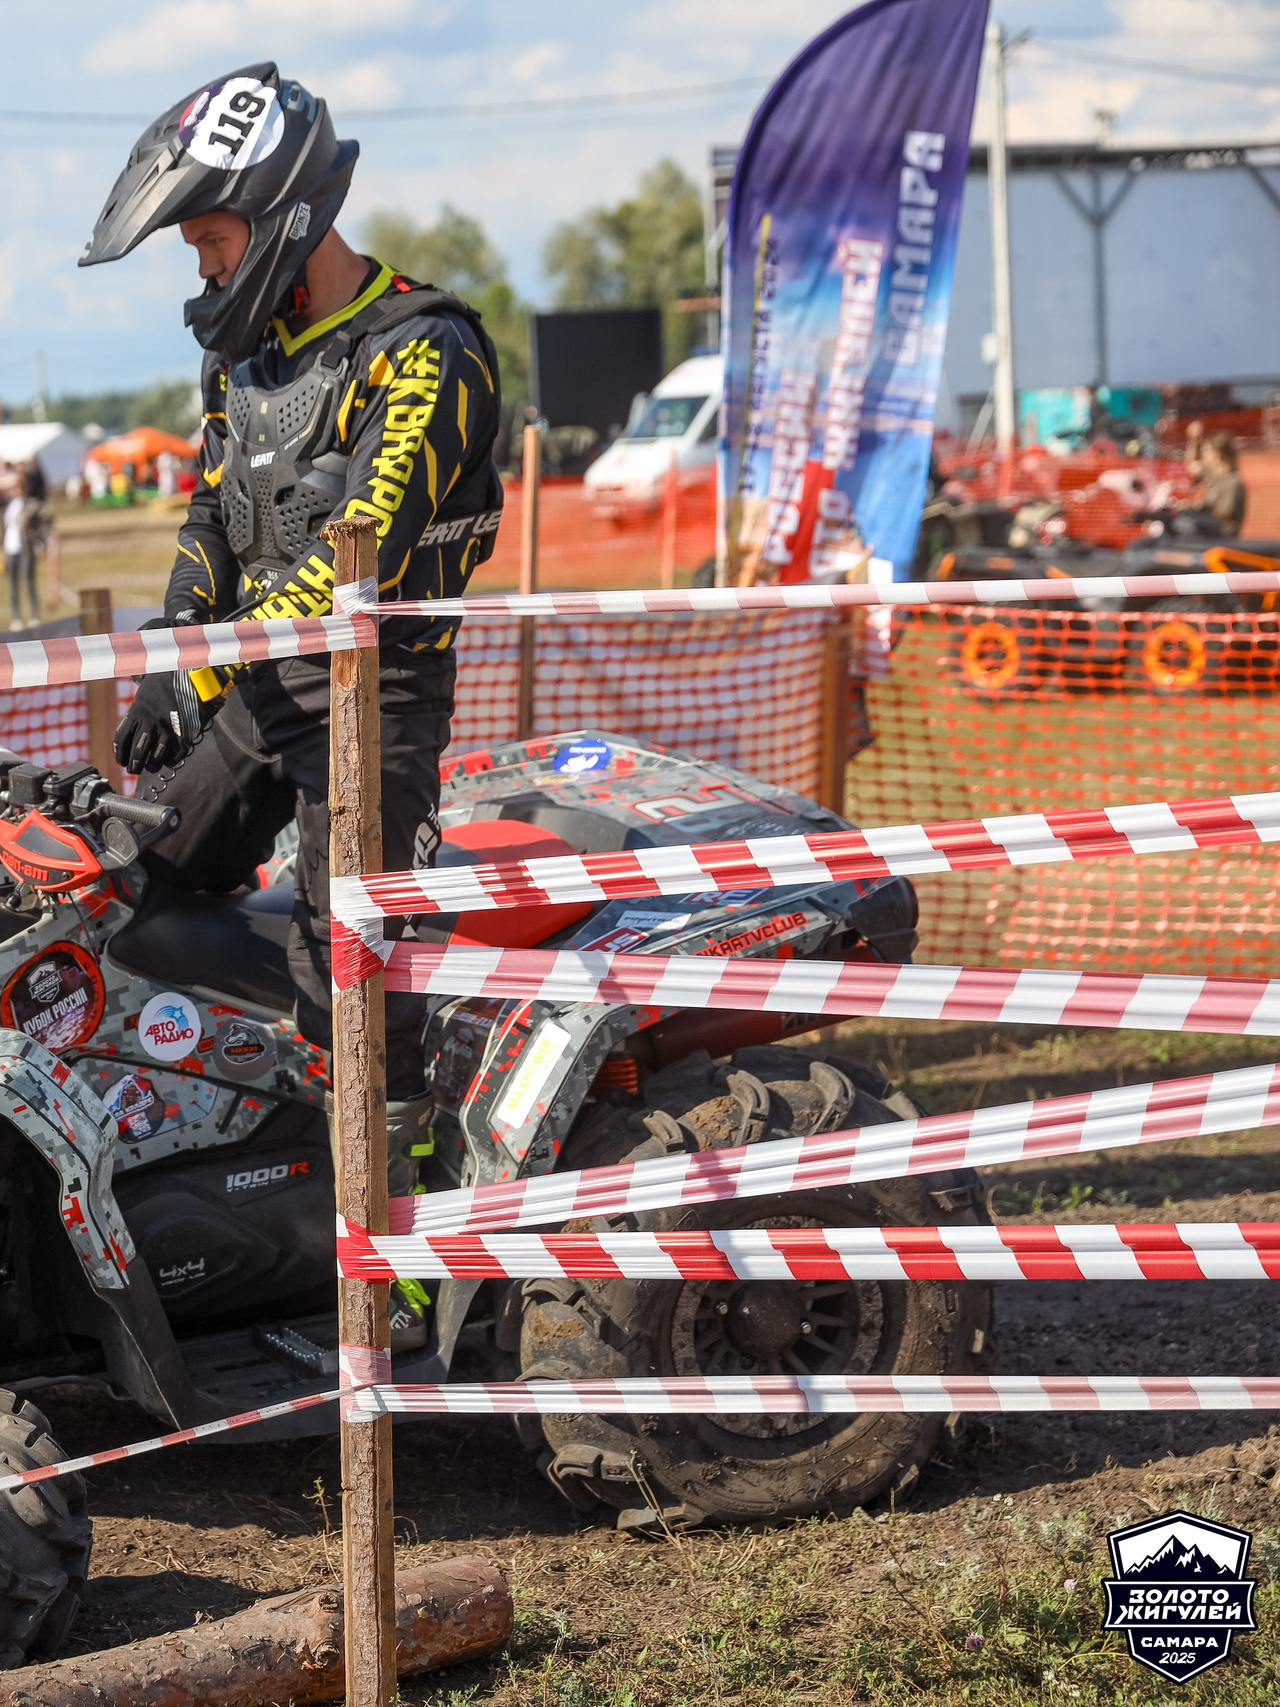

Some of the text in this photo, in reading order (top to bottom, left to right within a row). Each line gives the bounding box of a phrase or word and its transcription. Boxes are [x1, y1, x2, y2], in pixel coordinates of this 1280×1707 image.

[208, 90, 266, 157] 119
[882, 130, 946, 365] САМАРА
[250, 451, 275, 469] LEATT
[763, 368, 817, 565] РОССИИ
[2, 850, 49, 882] can-am
[23, 1008, 54, 1036] КУБОК
[52, 987, 88, 1019] РОССИИ
[144, 1020, 175, 1037] АВТО
[154, 1028, 194, 1045] РАДИО
[226, 1161, 310, 1189] 1000R
[159, 1257, 205, 1278] 4x4
